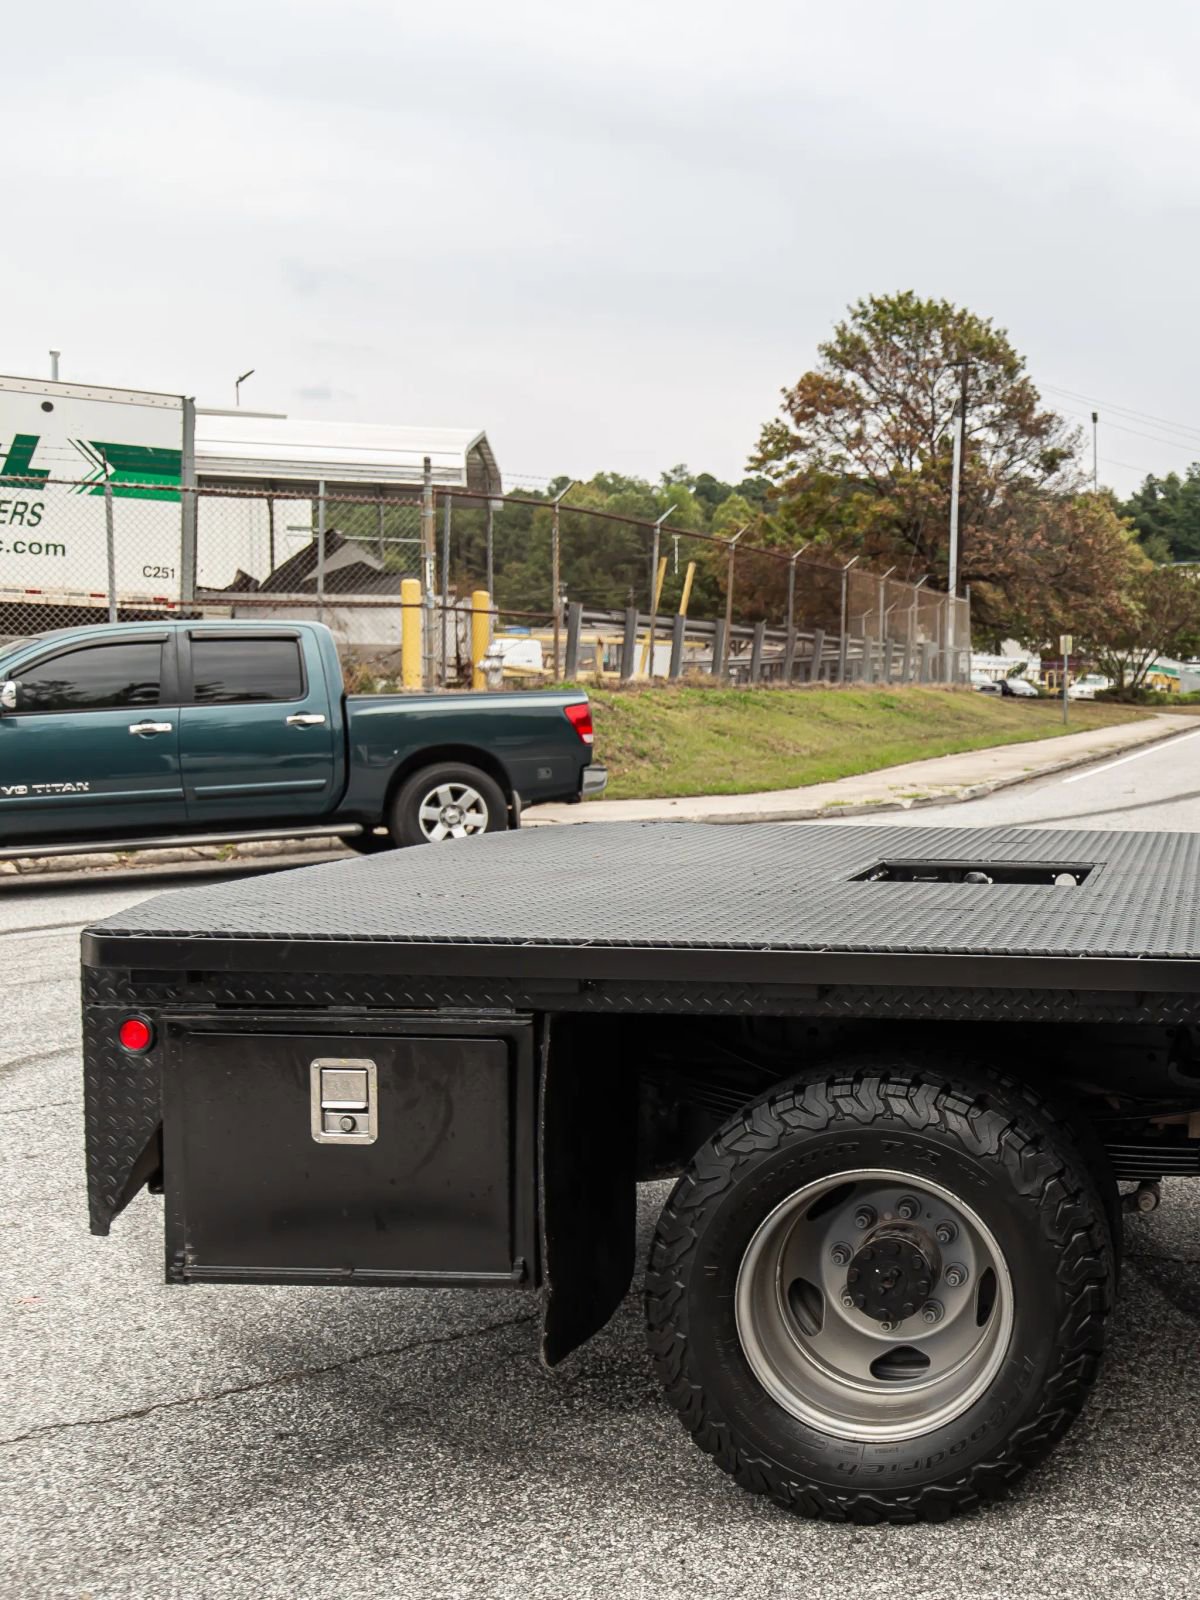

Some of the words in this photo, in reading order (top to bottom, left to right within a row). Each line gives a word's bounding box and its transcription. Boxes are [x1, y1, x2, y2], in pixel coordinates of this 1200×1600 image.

[0, 499, 45, 527] ERS
[0, 540, 66, 557] .com
[142, 565, 175, 579] C251
[31, 781, 90, 794] TITAN
